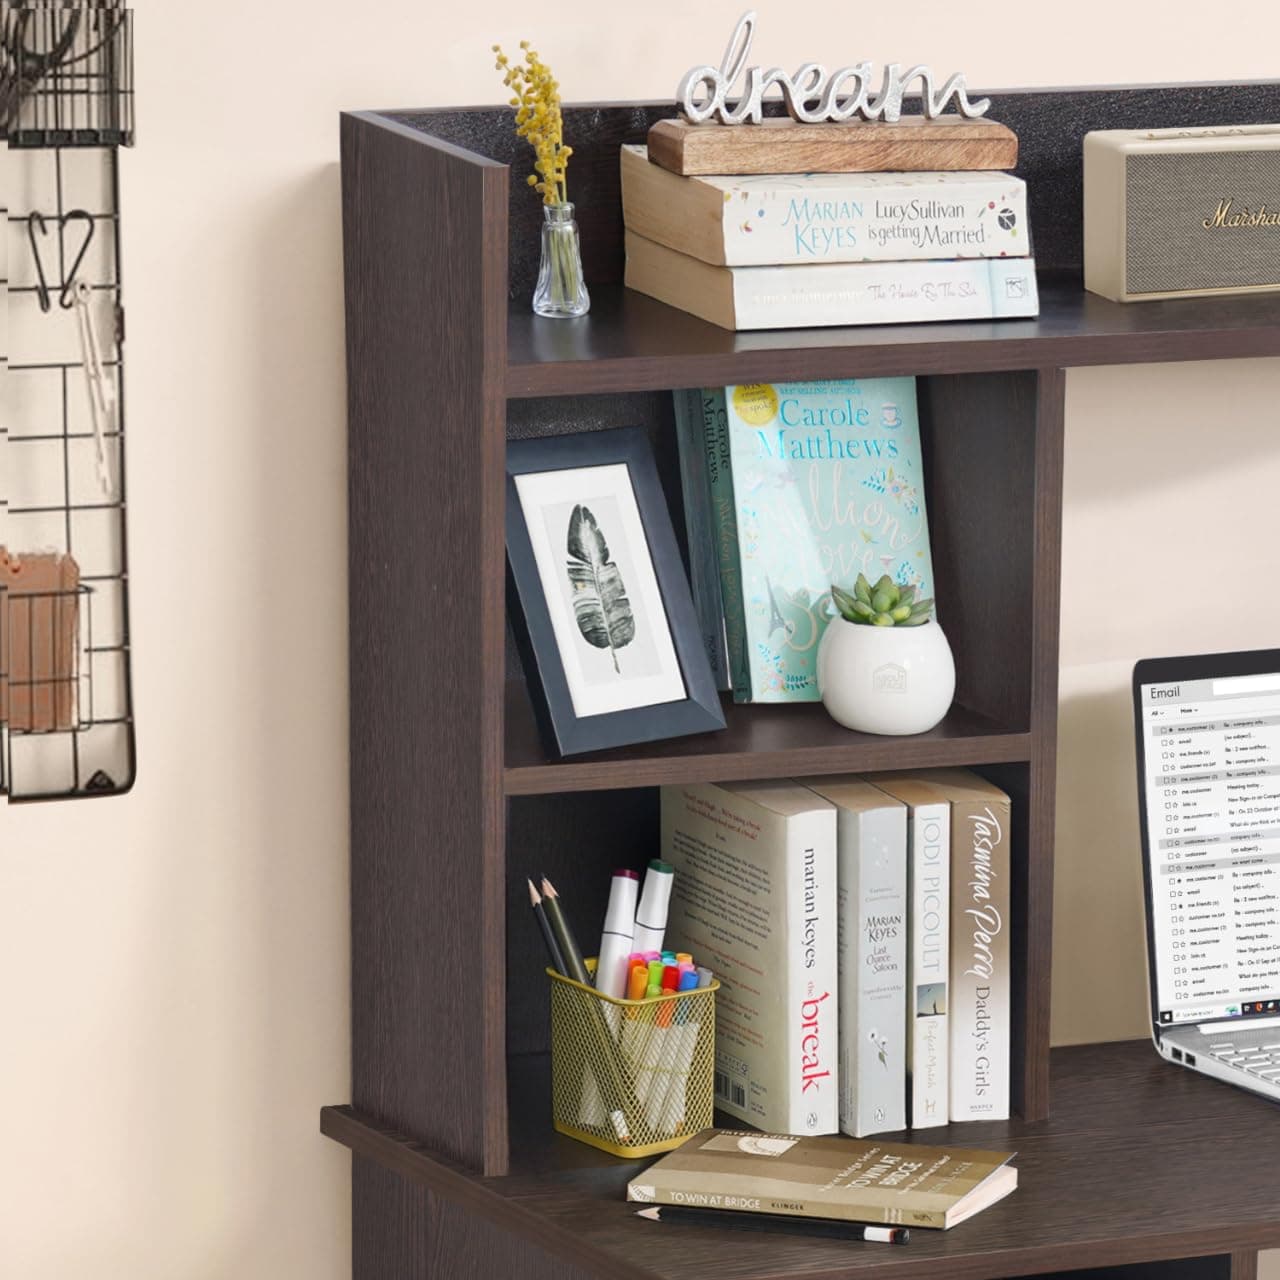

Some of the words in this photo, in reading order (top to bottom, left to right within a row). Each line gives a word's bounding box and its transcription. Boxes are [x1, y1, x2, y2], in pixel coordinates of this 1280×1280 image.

[676, 9, 991, 125] dream
[782, 197, 864, 227] MARIAN
[875, 200, 909, 223] Lucy
[906, 199, 965, 220] Sullivan
[794, 222, 857, 256] KEYES
[868, 225, 877, 240] is
[878, 225, 921, 246] getting
[918, 223, 986, 249] Married
[779, 399, 871, 427] Carole
[703, 396, 722, 484] Matthews
[716, 408, 731, 471] Carole
[757, 429, 899, 460] Matthews
[1150, 686, 1180, 699] Email
[920, 816, 941, 868] JODI
[966, 807, 1002, 903] Tasmina
[804, 848, 819, 913] marian
[864, 914, 902, 932] MARIAN
[868, 926, 898, 943] KEYES
[921, 875, 941, 973] PICOULT
[801, 917, 819, 969] keyes
[873, 945, 888, 956] Last
[964, 904, 1002, 980] Perry
[871, 963, 899, 975] Saloon
[972, 985, 991, 1052] Daddy's
[801, 990, 832, 1095] break
[974, 1055, 991, 1097] Girls
[858, 1163, 893, 1180] WIN
[878, 1161, 924, 1186] BRIDGE
[879, 1154, 903, 1166] AT
[845, 1178, 872, 1190] TO
[670, 1191, 684, 1203] TO
[684, 1192, 708, 1205] WIN
[709, 1194, 722, 1206] AT
[725, 1196, 761, 1210] BRIDGE
[770, 1201, 805, 1211] KLINGER
